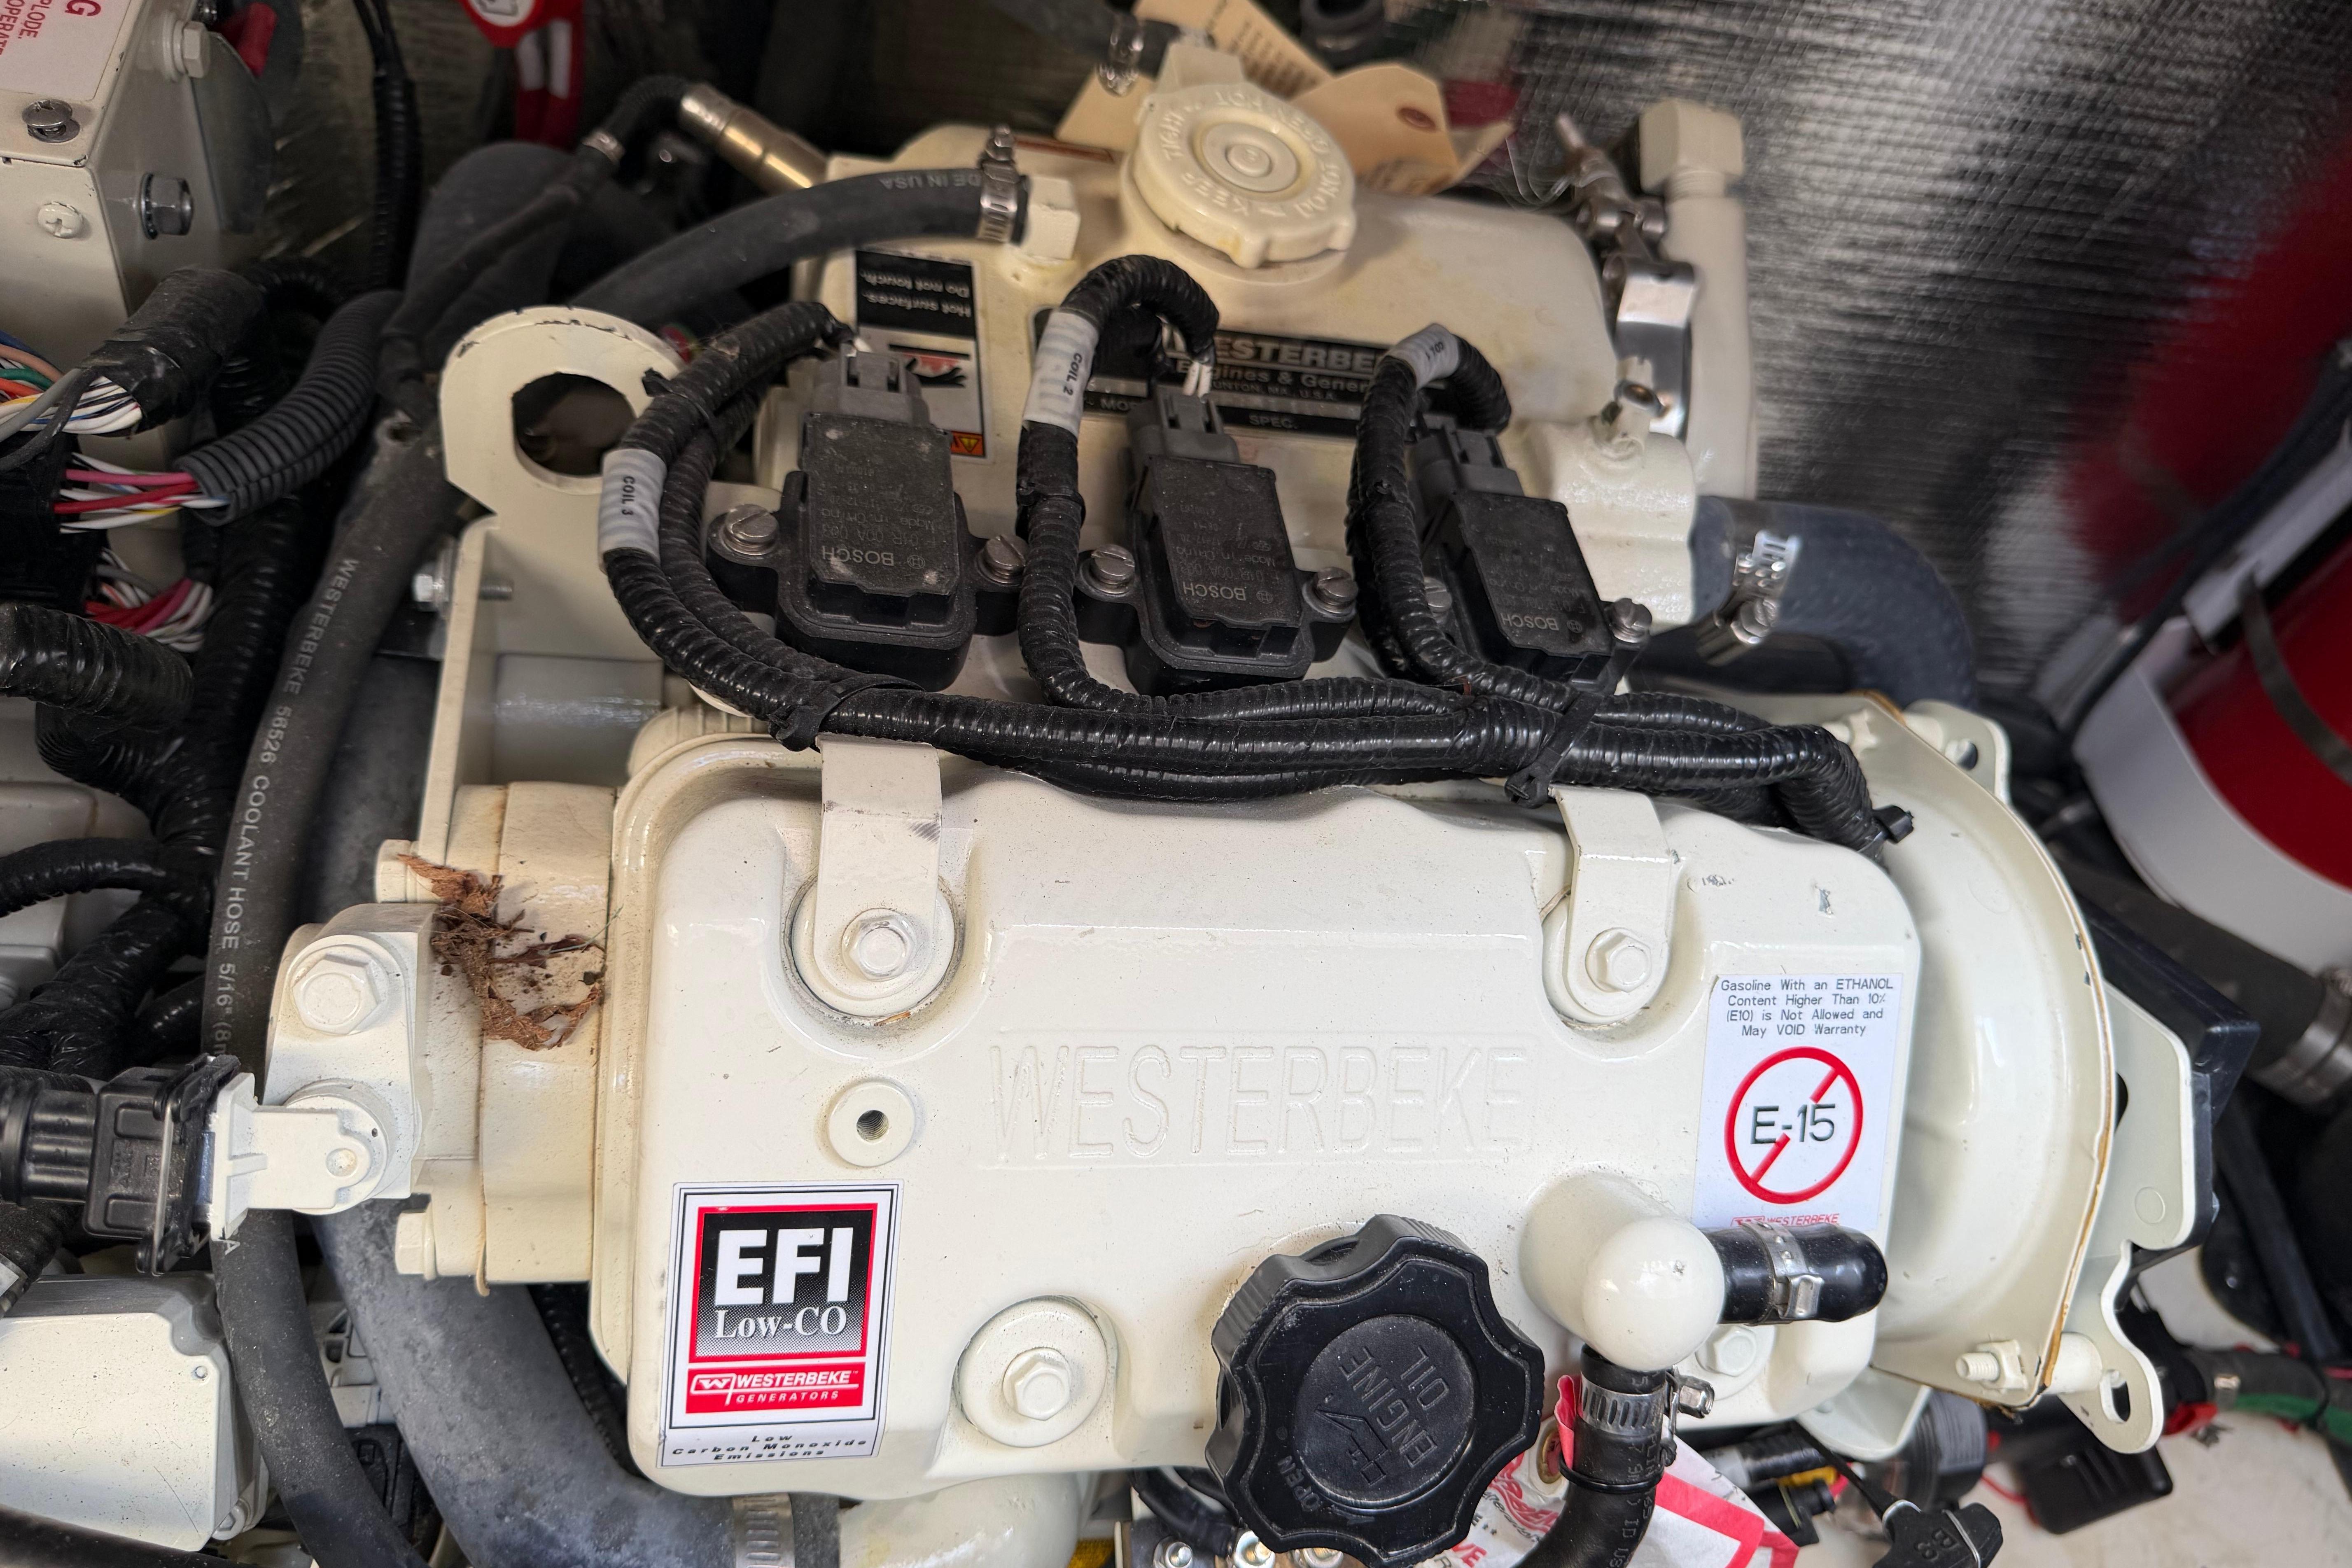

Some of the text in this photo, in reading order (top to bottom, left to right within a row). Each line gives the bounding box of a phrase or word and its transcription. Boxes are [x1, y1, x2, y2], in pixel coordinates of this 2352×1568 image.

[1213, 336, 1375, 373] ESTERBE
[1063, 353, 1083, 396] COIL 2
[1300, 374, 1369, 392] Gener
[621, 476, 636, 505] COIL
[822, 546, 894, 566] BOSCH
[1183, 581, 1246, 601] BOSCH
[282, 558, 359, 695] WESTERBEKE
[1500, 613, 1559, 631] BOSCH
[231, 775, 270, 881] COOLANT
[221, 887, 247, 950] HOSE
[1721, 978, 1893, 991] Gasoline With an ETHANOL
[1728, 993, 1886, 1008] Content Higher Than 10%
[1726, 1008, 1883, 1022] (E10) is Not Allowed and
[1741, 1023, 1866, 1038] May VOID Warranty
[987, 1045, 1528, 1161] WESTERBEKE
[1750, 1103, 1836, 1145] E-15
[715, 1227, 854, 1306] EFI
[735, 1370, 852, 1388] WESTERBEKE
[1400, 1345, 1449, 1411] OIL
[736, 1391, 839, 1404] GENERATORS
[1338, 1346, 1438, 1469] ENGINE
[672, 1440, 866, 1455] Carbon Monoxide
[714, 1449, 824, 1461] Emissions
[1277, 1455, 1321, 1512] OPEN
